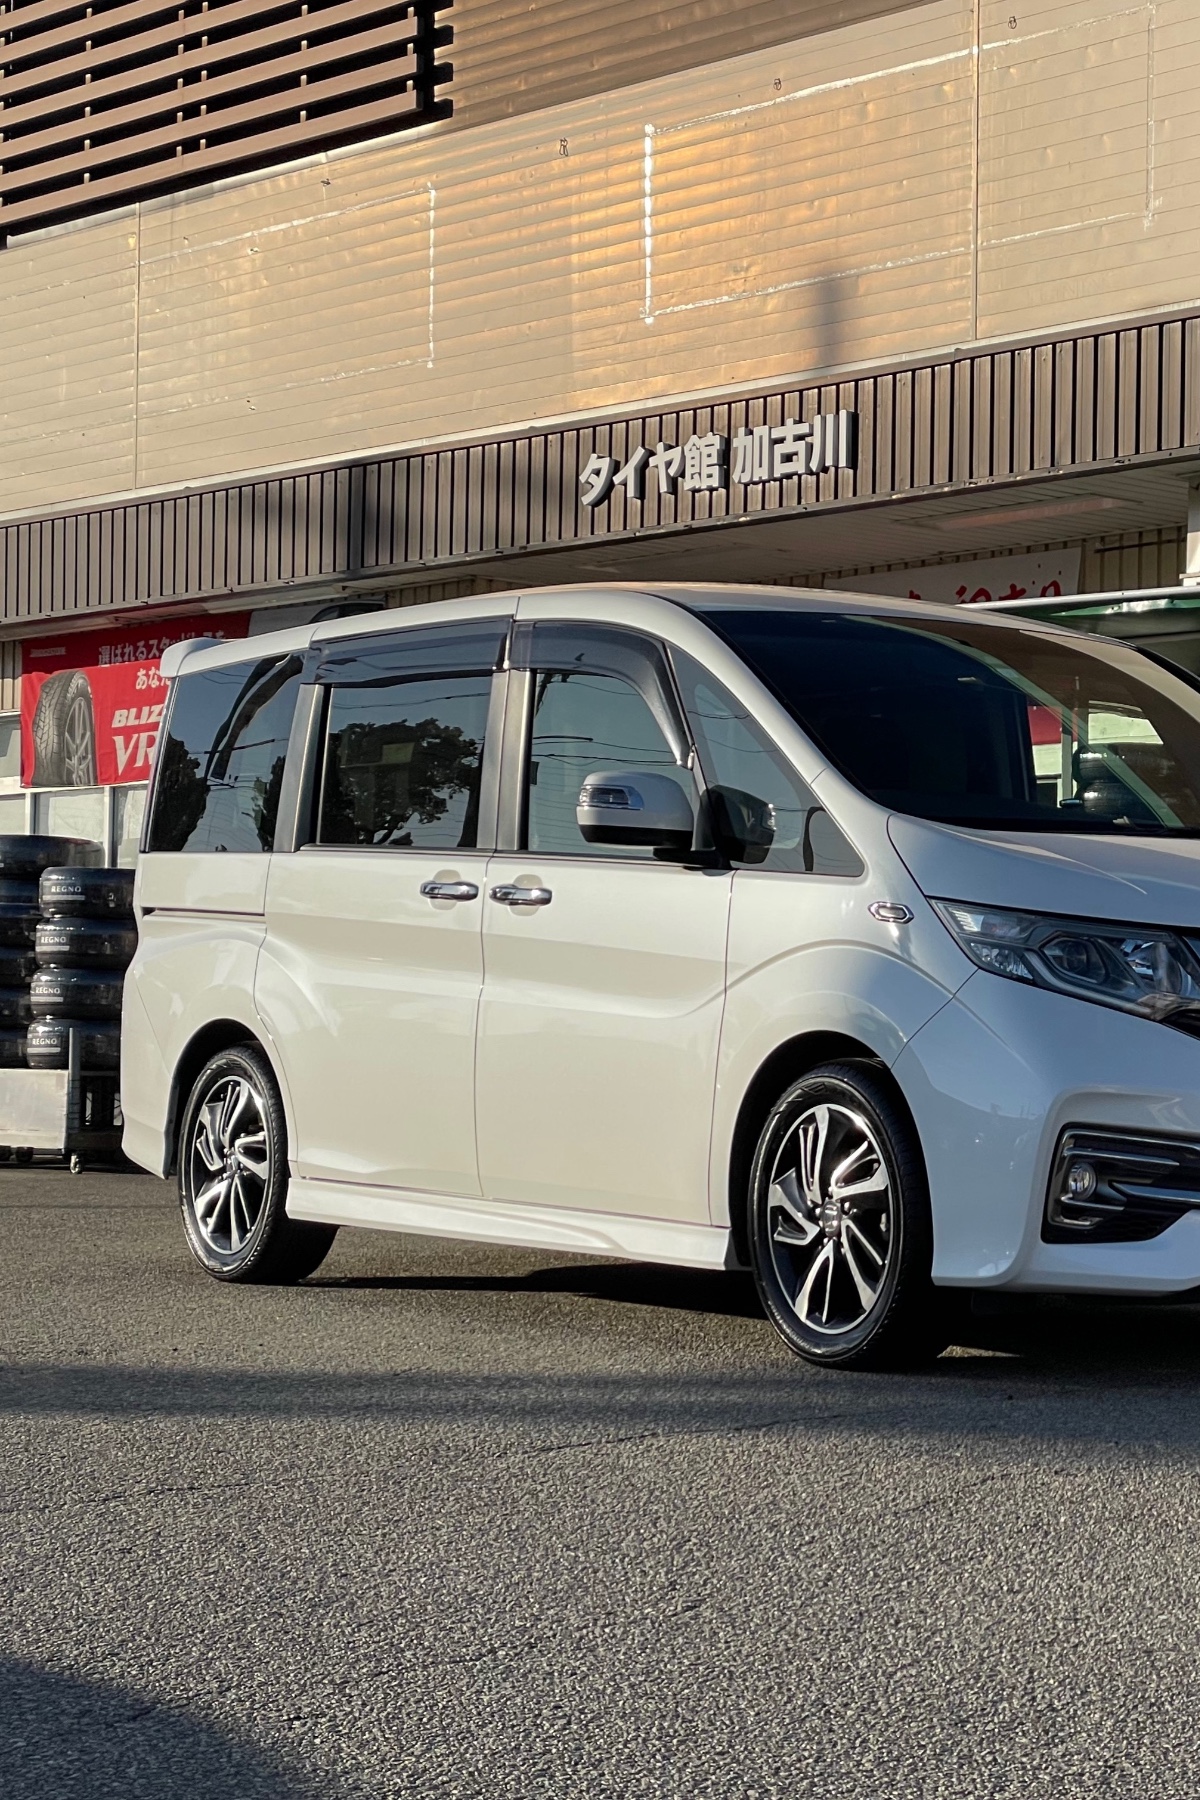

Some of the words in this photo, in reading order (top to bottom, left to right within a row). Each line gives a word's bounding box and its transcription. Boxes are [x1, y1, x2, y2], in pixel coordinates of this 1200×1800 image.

[579, 432, 725, 506] タイヤ館
[732, 409, 855, 484] 加古川
[51, 885, 82, 893] REGNO
[41, 936, 67, 944] REGNO
[35, 986, 61, 994] REGNO
[32, 1037, 58, 1045] REGNO
